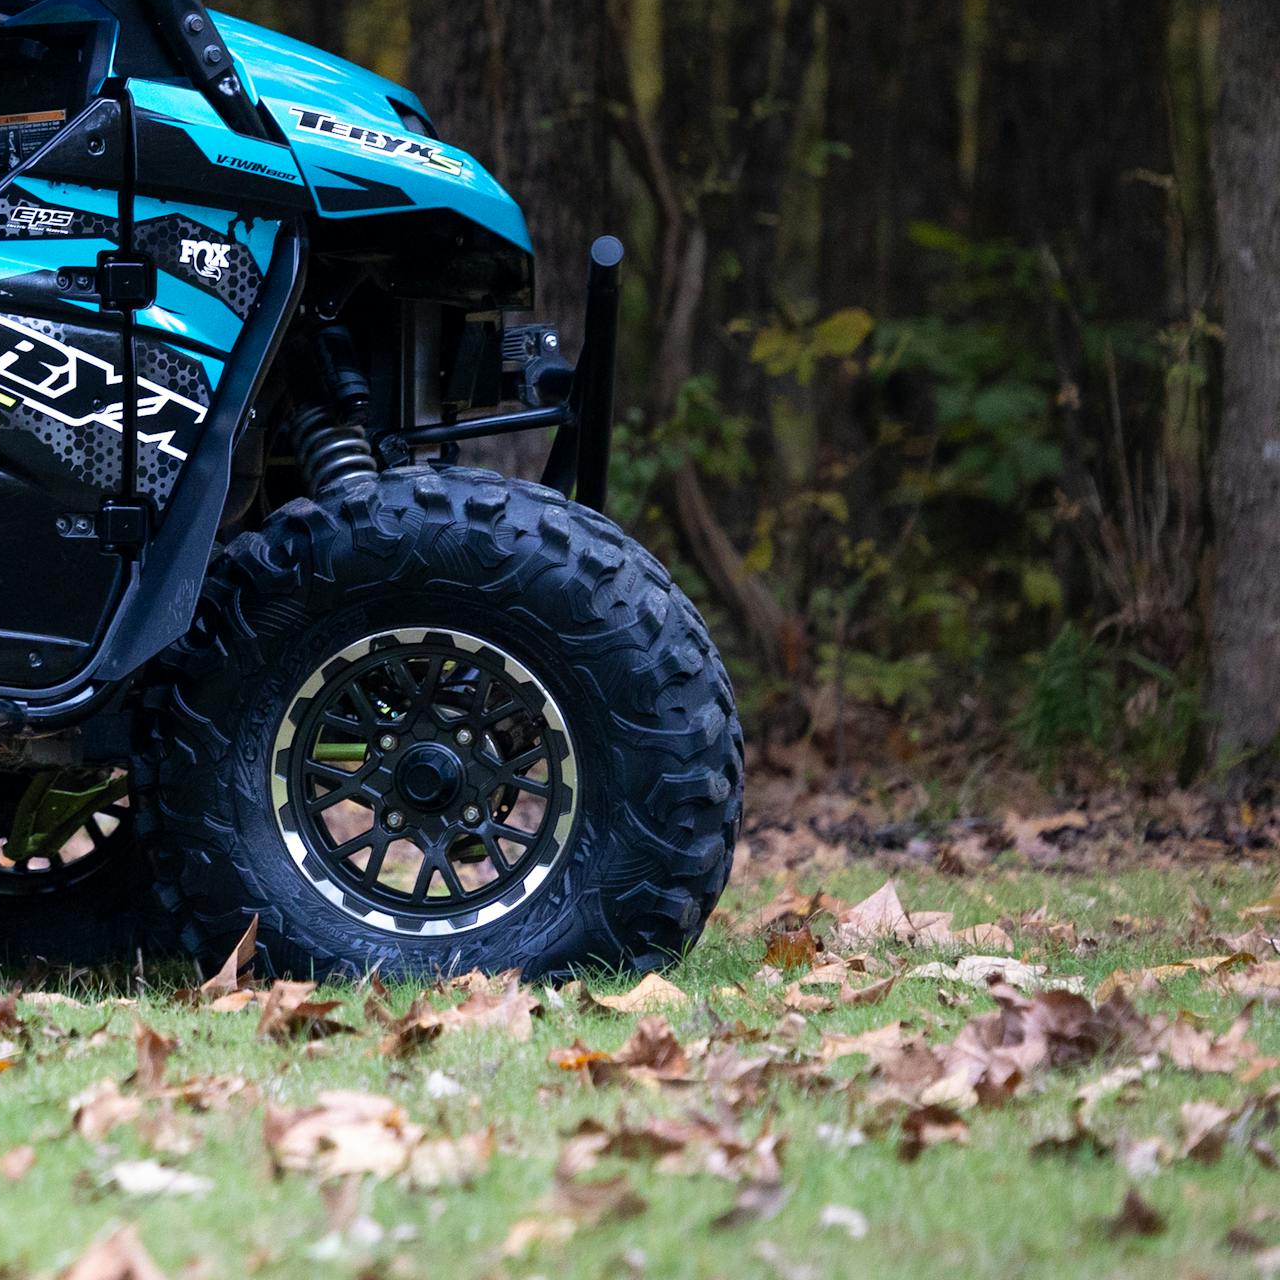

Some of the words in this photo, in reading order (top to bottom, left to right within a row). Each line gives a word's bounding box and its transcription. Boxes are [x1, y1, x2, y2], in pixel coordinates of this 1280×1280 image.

[290, 106, 442, 158] TERYX
[11, 206, 74, 227] EPS
[179, 239, 231, 281] FOX
